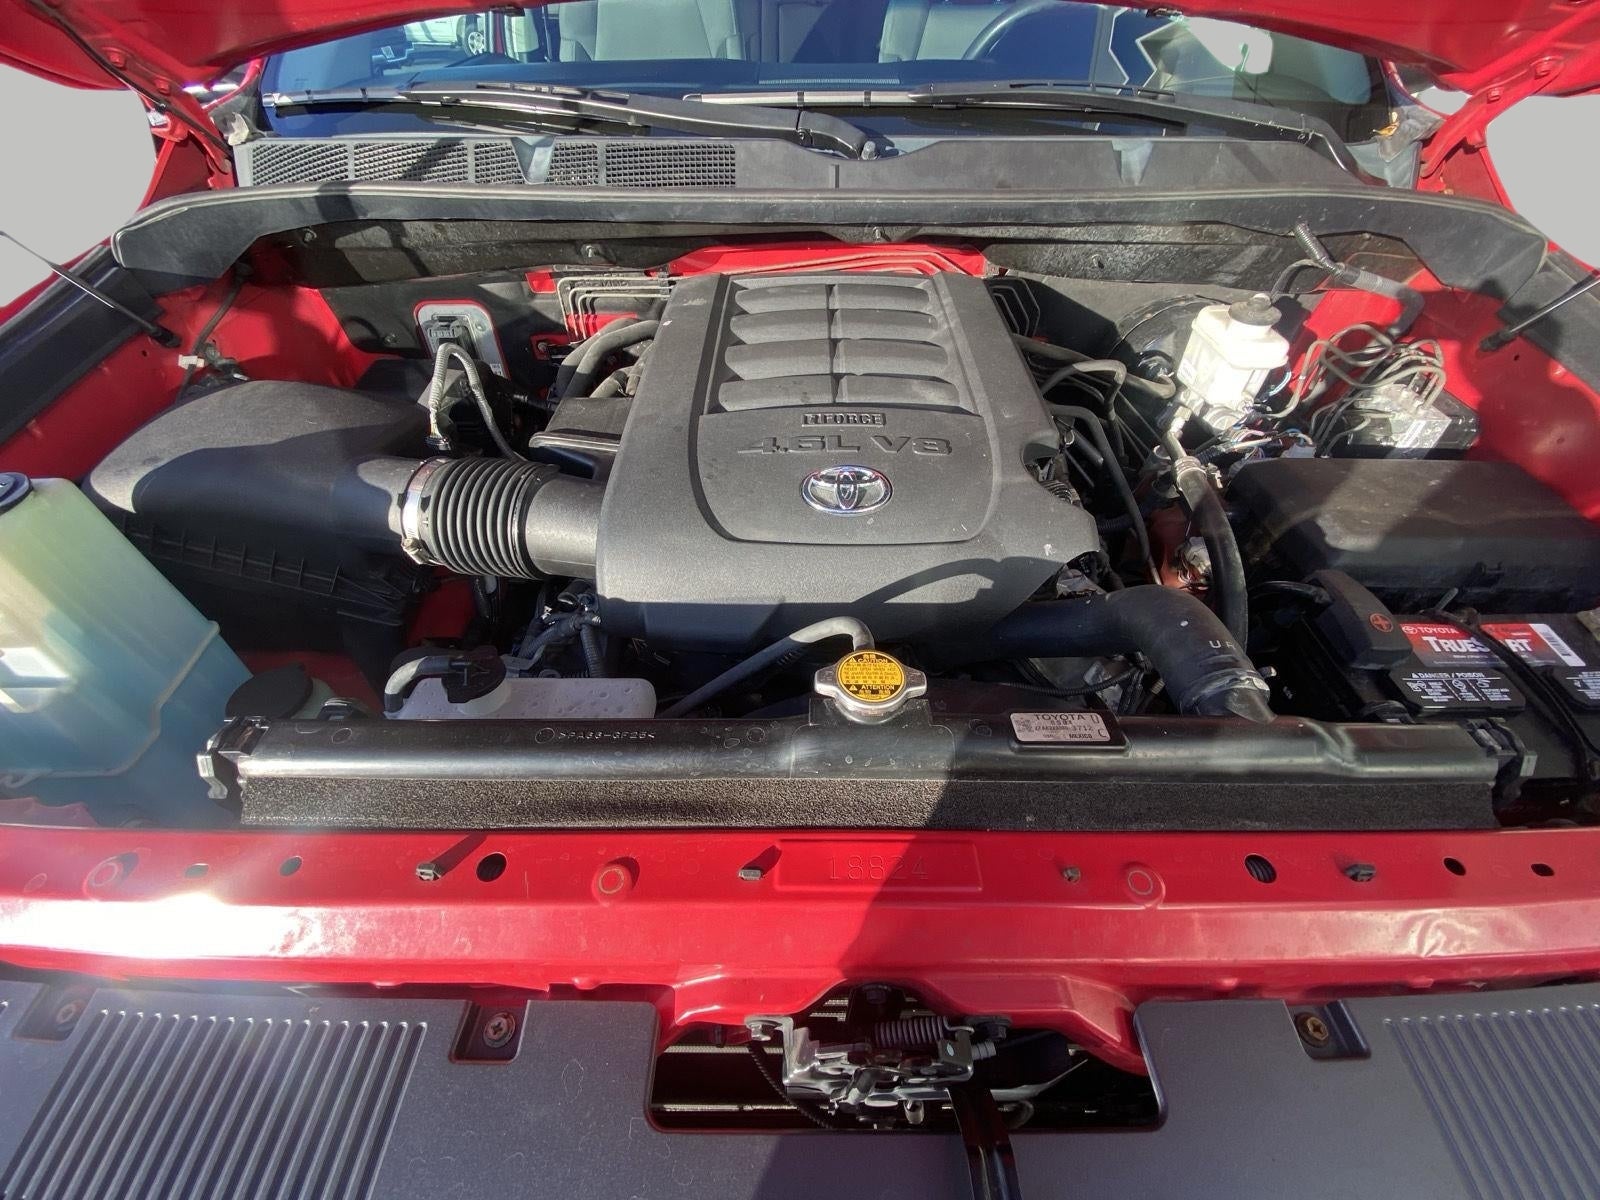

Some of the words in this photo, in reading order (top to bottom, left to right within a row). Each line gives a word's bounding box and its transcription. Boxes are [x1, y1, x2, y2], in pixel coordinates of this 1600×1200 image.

[738, 435, 861, 454] 4.6L
[870, 435, 952, 455] V8
[1417, 626, 1459, 634] TOYOTA
[1421, 635, 1533, 652] TRUESRT
[1034, 713, 1086, 721] TOYOTA
[829, 855, 928, 880] 18824
